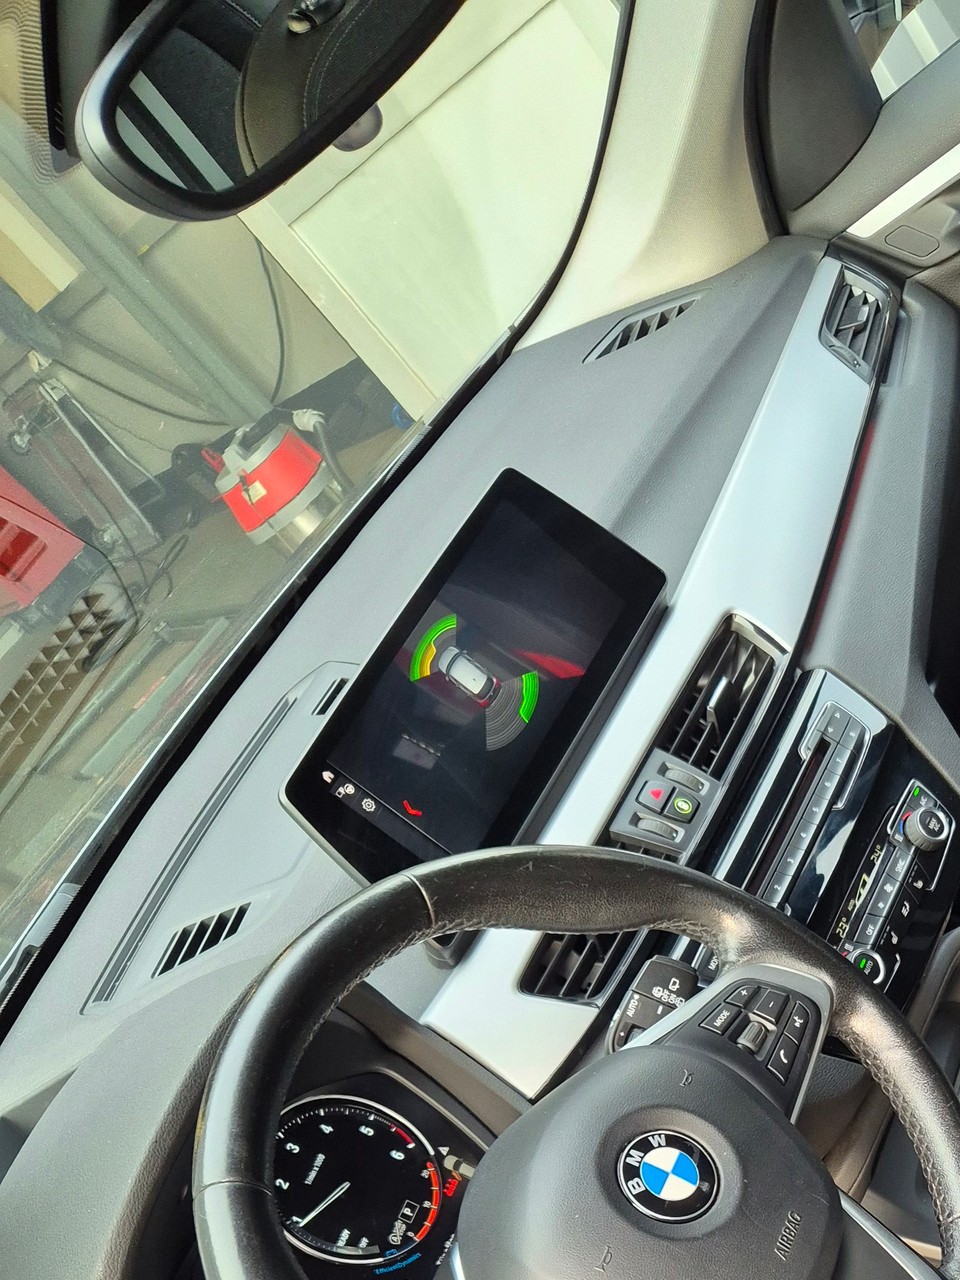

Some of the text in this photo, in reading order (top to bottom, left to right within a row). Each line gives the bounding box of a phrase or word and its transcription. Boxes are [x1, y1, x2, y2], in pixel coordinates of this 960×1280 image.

[866, 924, 876, 936] OFF
[864, 960, 874, 976] AUTO
[626, 1000, 638, 1018] AUTO
[714, 1009, 730, 1028] MODE
[319, 1124, 334, 1134] 4
[358, 1125, 374, 1136] 5
[286, 1142, 300, 1154] 3
[390, 1150, 405, 1160] 6
[625, 1134, 667, 1196] BMW
[421, 1169, 430, 1179] 20
[275, 1178, 290, 1190] 2
[422, 1200, 432, 1208] 10
[402, 1206, 414, 1217] P
[774, 1210, 802, 1262] AIRBAG
